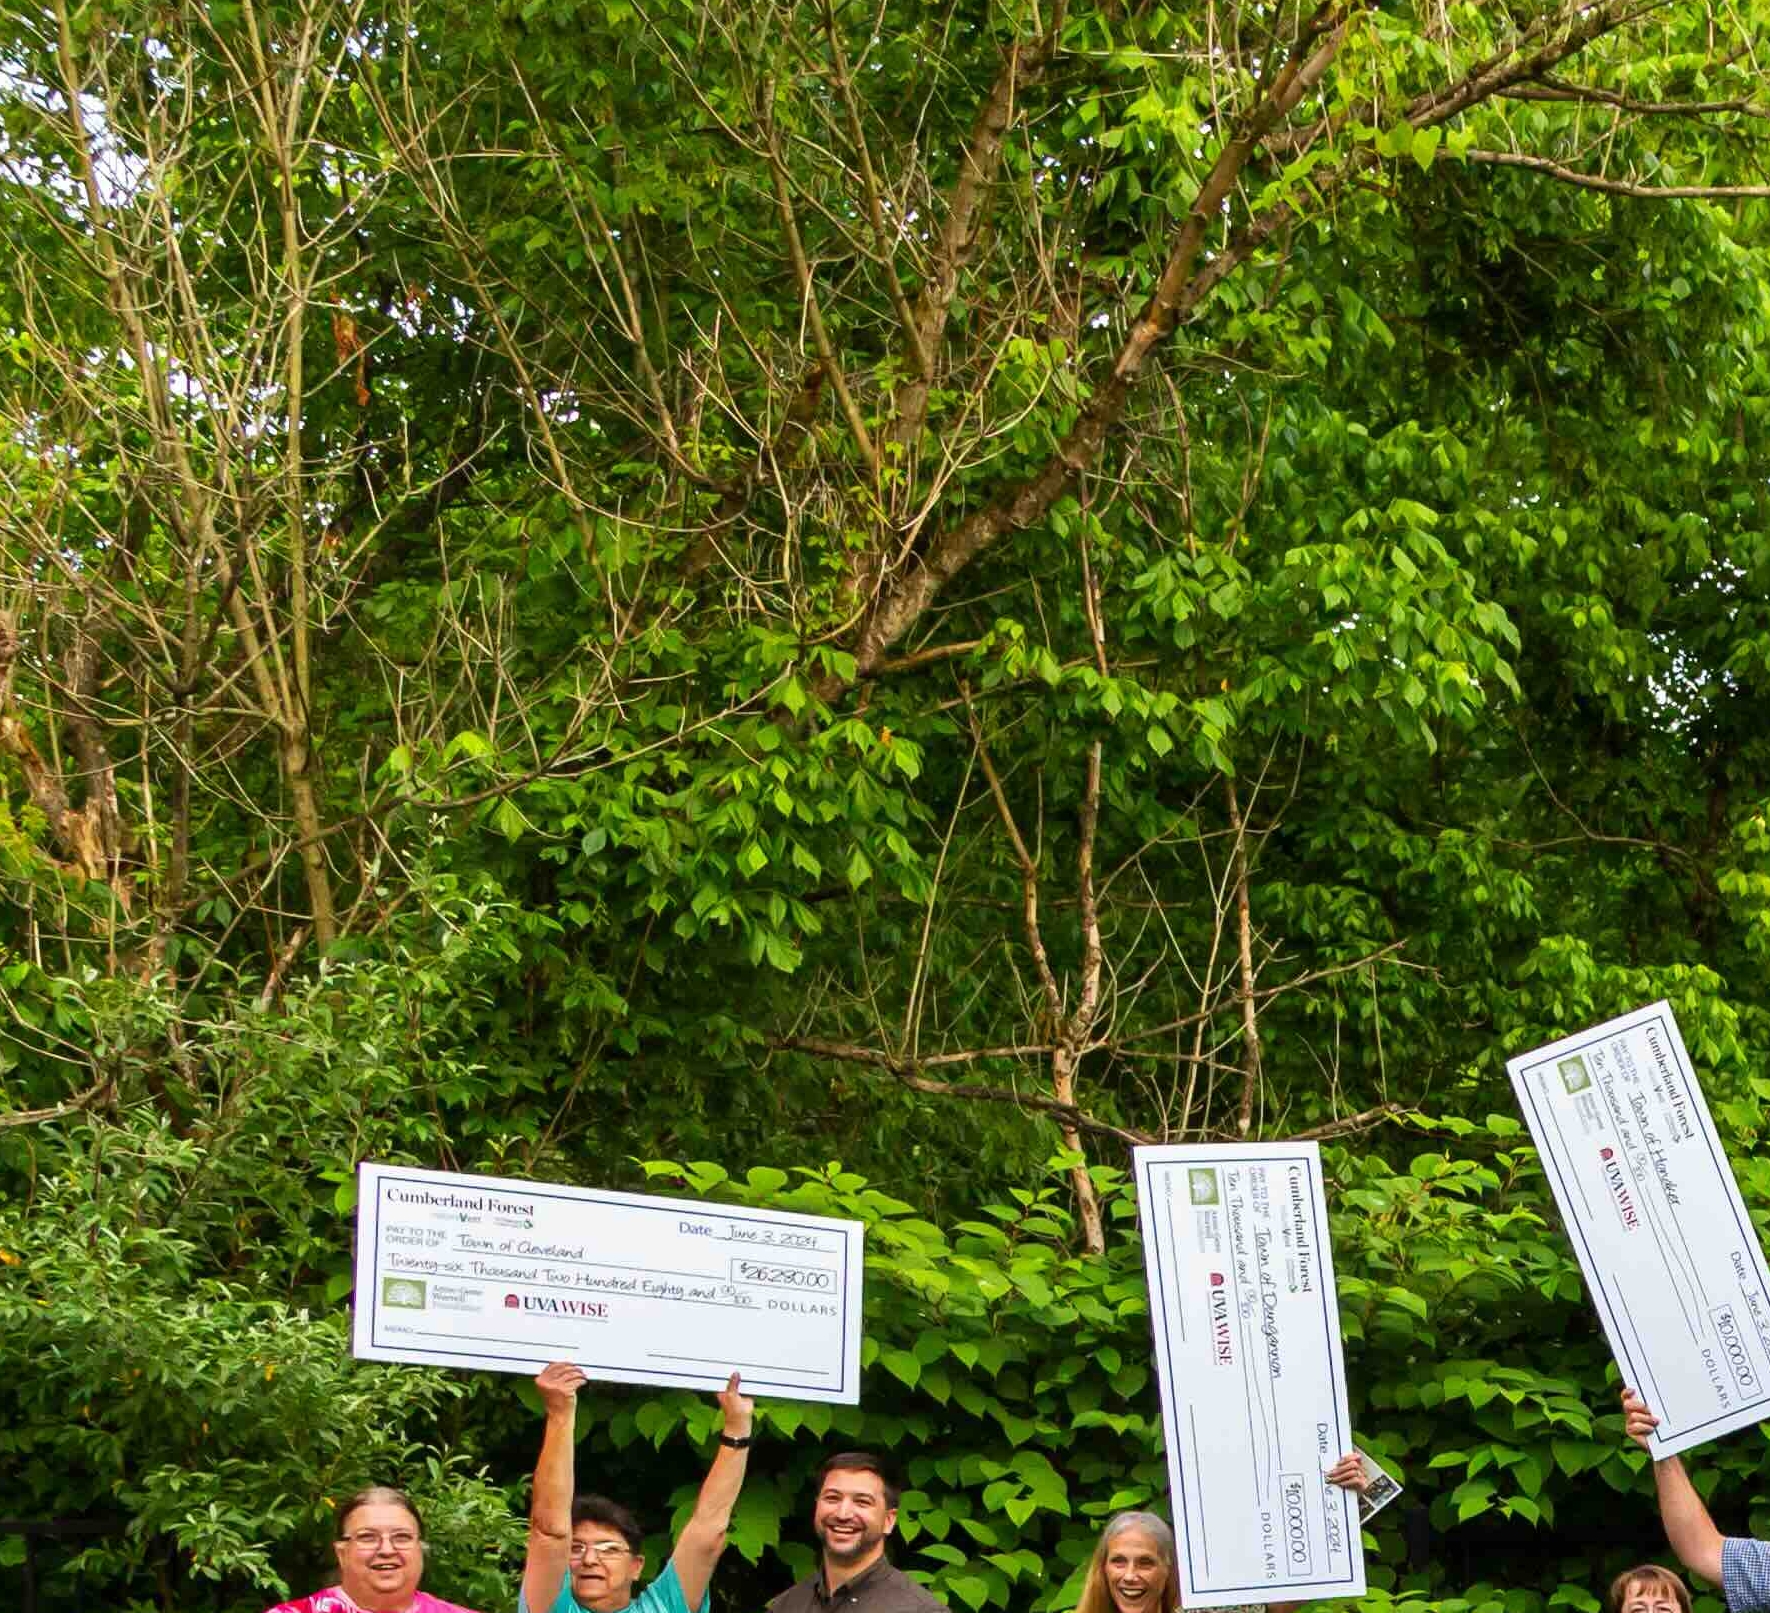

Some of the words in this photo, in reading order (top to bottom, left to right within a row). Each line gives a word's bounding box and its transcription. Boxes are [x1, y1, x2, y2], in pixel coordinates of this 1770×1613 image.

[1645, 1026, 1680, 1099] Cumberland
[1673, 1101, 1694, 1139] Forest
[1593, 1049, 1606, 1069] Ten
[1601, 1072, 1629, 1125] Thousand
[1620, 1127, 1637, 1150] and
[1631, 1091, 1652, 1129] Town
[1644, 1130, 1661, 1146] of
[1228, 1170, 1241, 1190] Ten
[387, 1188, 482, 1210] Cumberland
[488, 1199, 533, 1216] Forest
[385, 1234, 422, 1245] ORDER
[386, 1225, 404, 1234] PAY
[409, 1227, 423, 1235] TO
[427, 1228, 445, 1238] THE
[679, 1221, 711, 1236] Date
[727, 1224, 757, 1243] June
[780, 1234, 816, 1248] 2024
[1231, 1196, 1248, 1255] Thousand
[1288, 1166, 1308, 1247] Cumberland
[1298, 1252, 1312, 1292] Forest
[456, 1234, 494, 1249] Town
[499, 1239, 512, 1251] of
[517, 1240, 583, 1259] Cleveland
[1255, 1228, 1273, 1267] Town
[470, 1260, 537, 1279] Thousand
[542, 1268, 571, 1283] Two
[575, 1272, 635, 1290] Hundred
[642, 1280, 682, 1300] Eighty
[689, 1286, 716, 1299] and
[1237, 1260, 1251, 1284] and
[1259, 1272, 1276, 1287] of
[1730, 1251, 1747, 1280] Date
[768, 1299, 836, 1316] DOLLARS
[1747, 1290, 1764, 1317] June
[1259, 1292, 1283, 1377] Dungannon
[1701, 1348, 1731, 1409] DOLLARS
[1316, 1423, 1329, 1453] Date
[1260, 1512, 1276, 1578] DOLLARS
[1326, 1517, 1341, 1553] 2024
